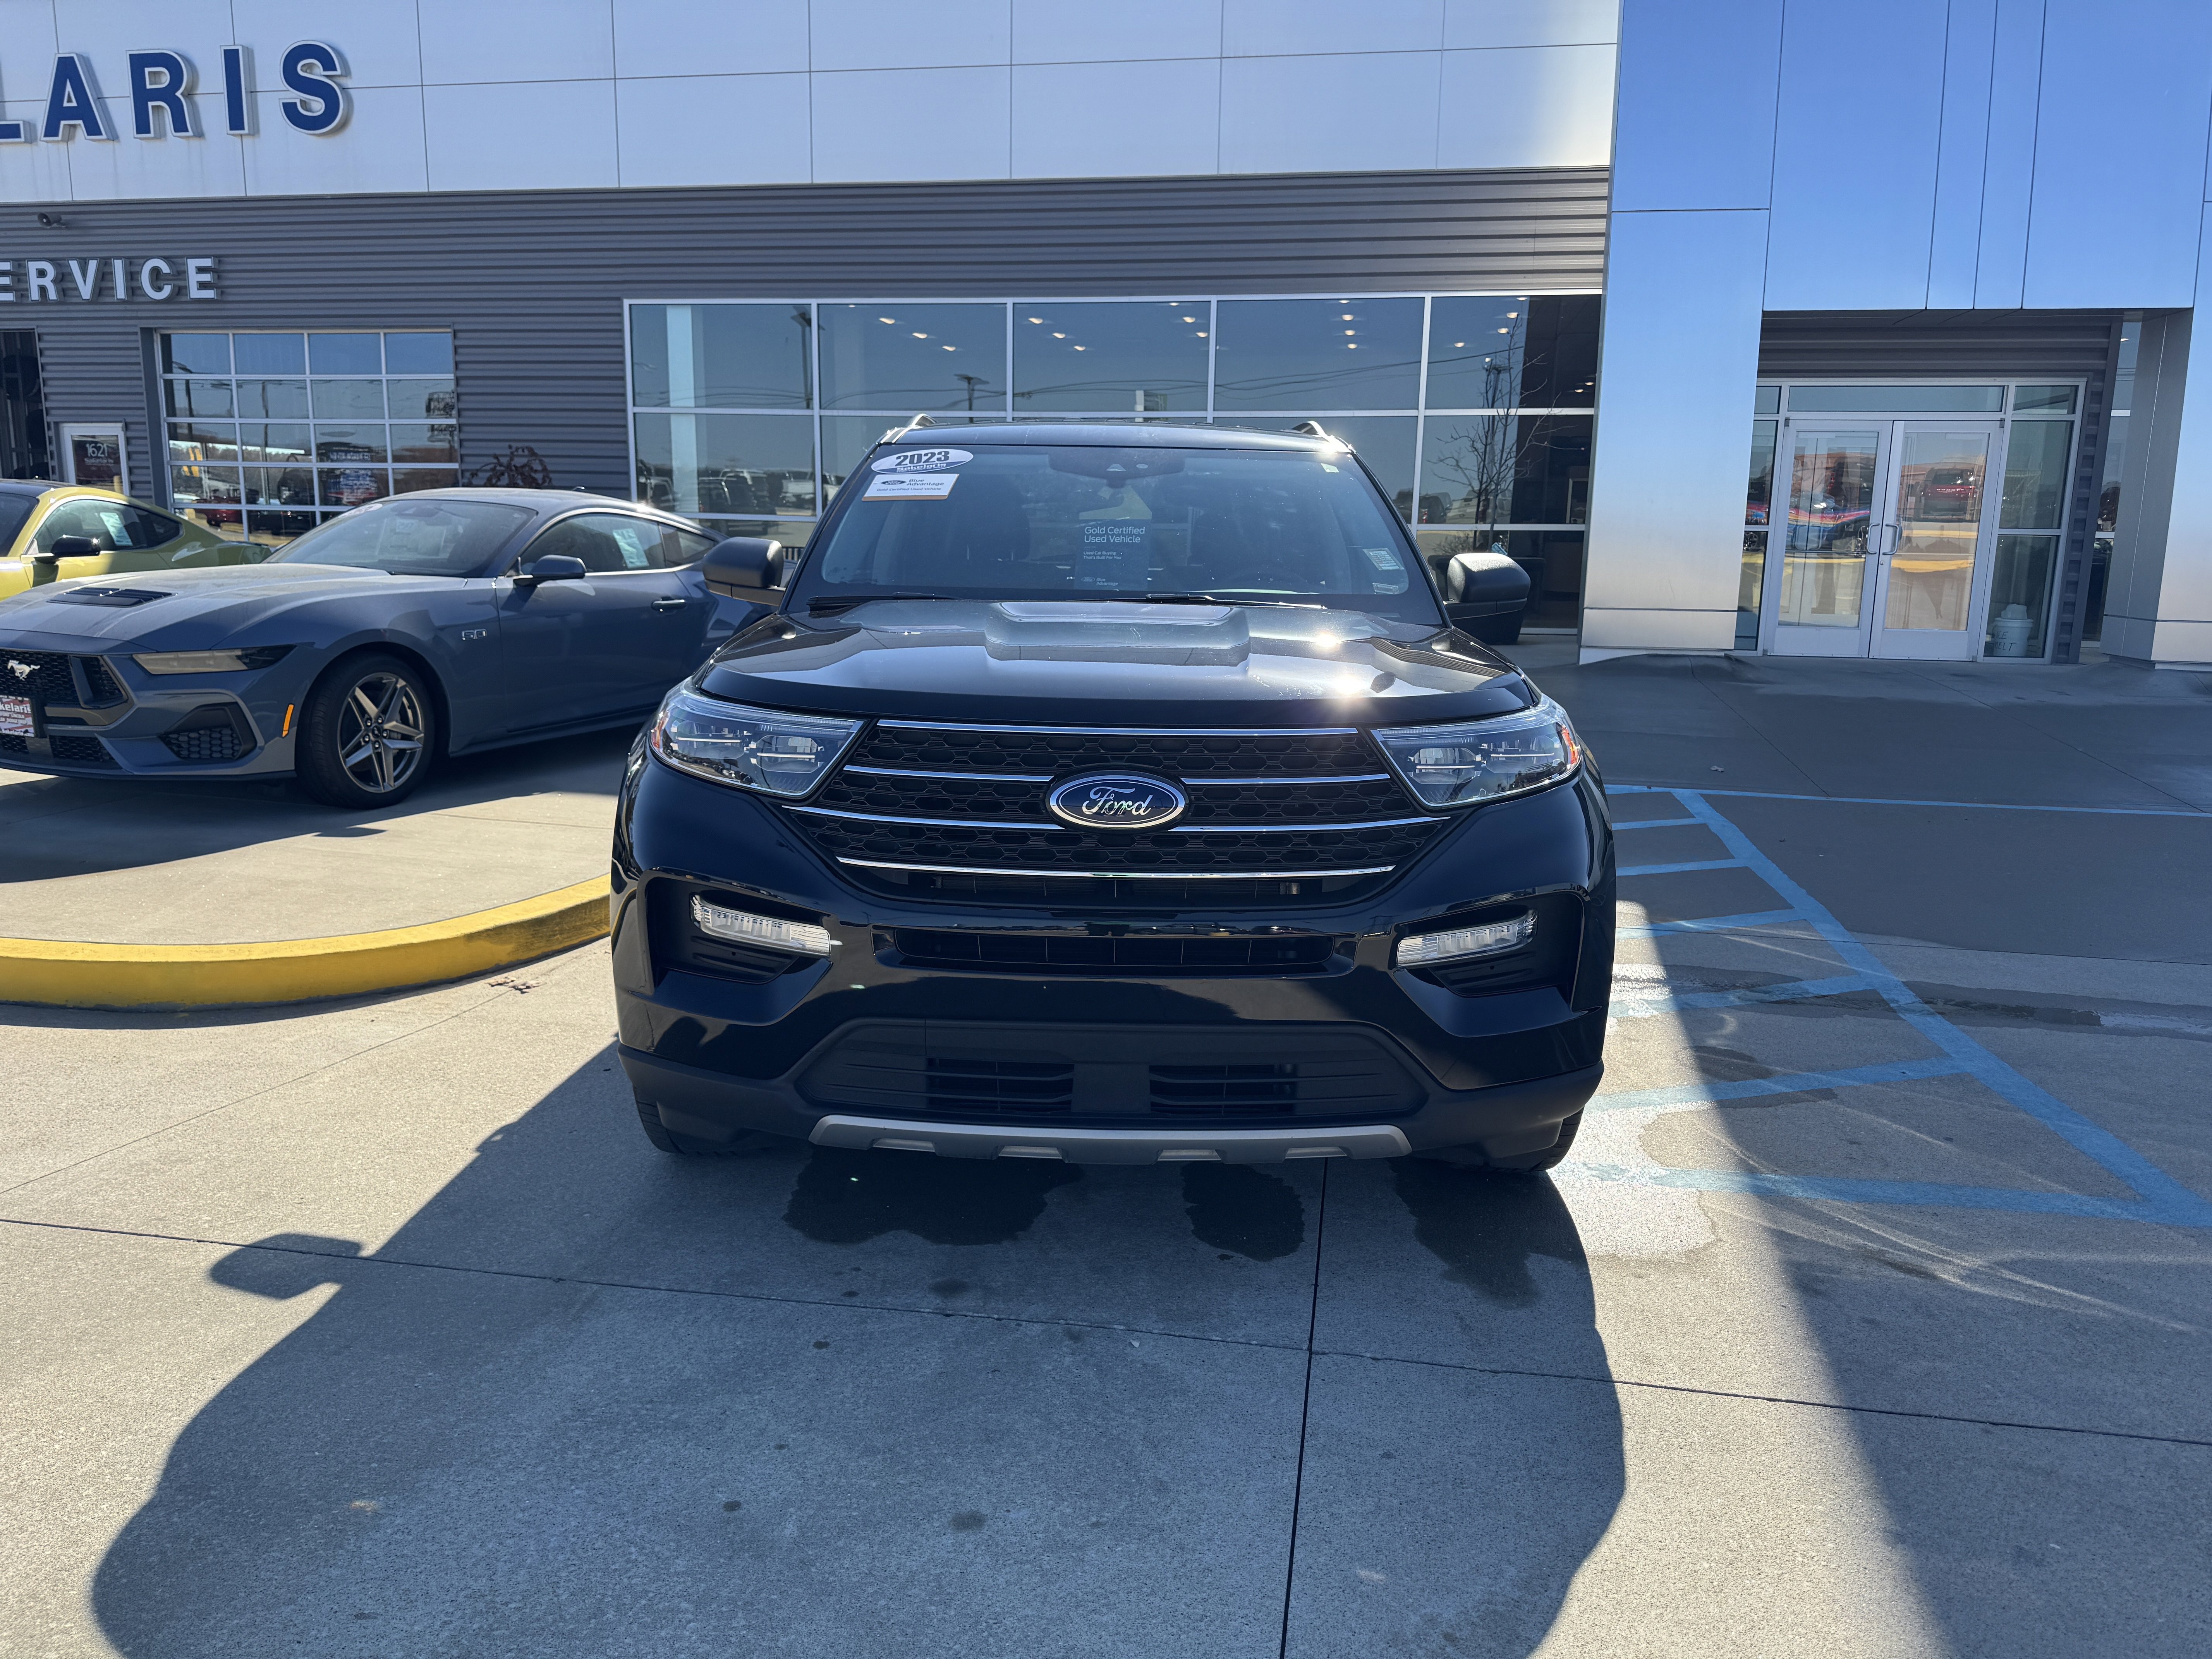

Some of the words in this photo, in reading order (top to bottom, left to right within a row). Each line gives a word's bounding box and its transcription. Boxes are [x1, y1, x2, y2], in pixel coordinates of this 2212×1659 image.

[86, 443, 108, 457] 1621
[895, 451, 950, 466] 2023
[1082, 786, 1153, 816] Ford
